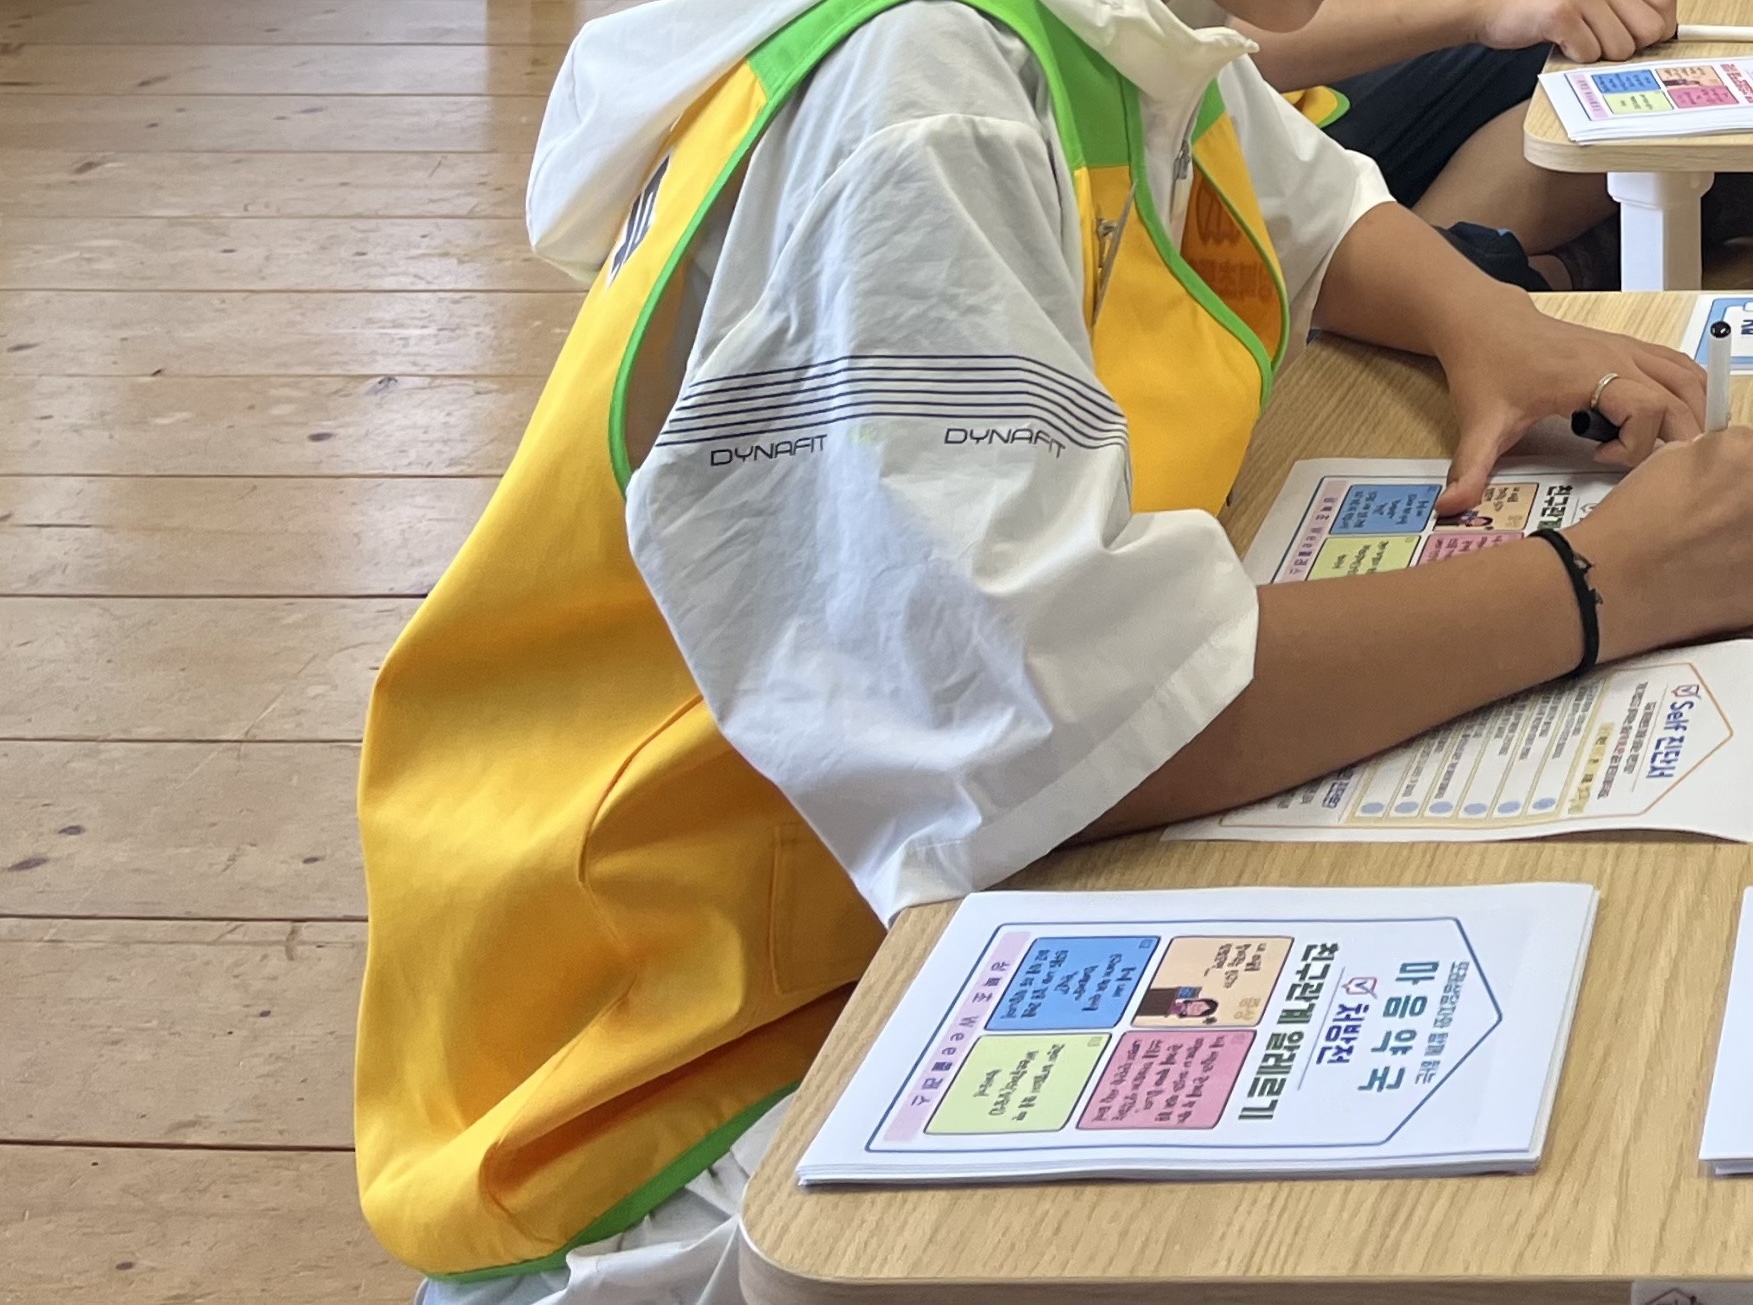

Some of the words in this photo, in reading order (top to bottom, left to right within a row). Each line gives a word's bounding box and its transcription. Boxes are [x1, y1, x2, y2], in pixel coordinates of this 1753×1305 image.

[710, 434, 828, 467] DYNAFIT
[944, 428, 1066, 459] DYNAFIT
[1664, 700, 1695, 733] Self
[1275, 942, 1341, 1025] 친구관계
[1315, 1003, 1370, 1066] 처방전
[1237, 1030, 1305, 1122] 알레르기
